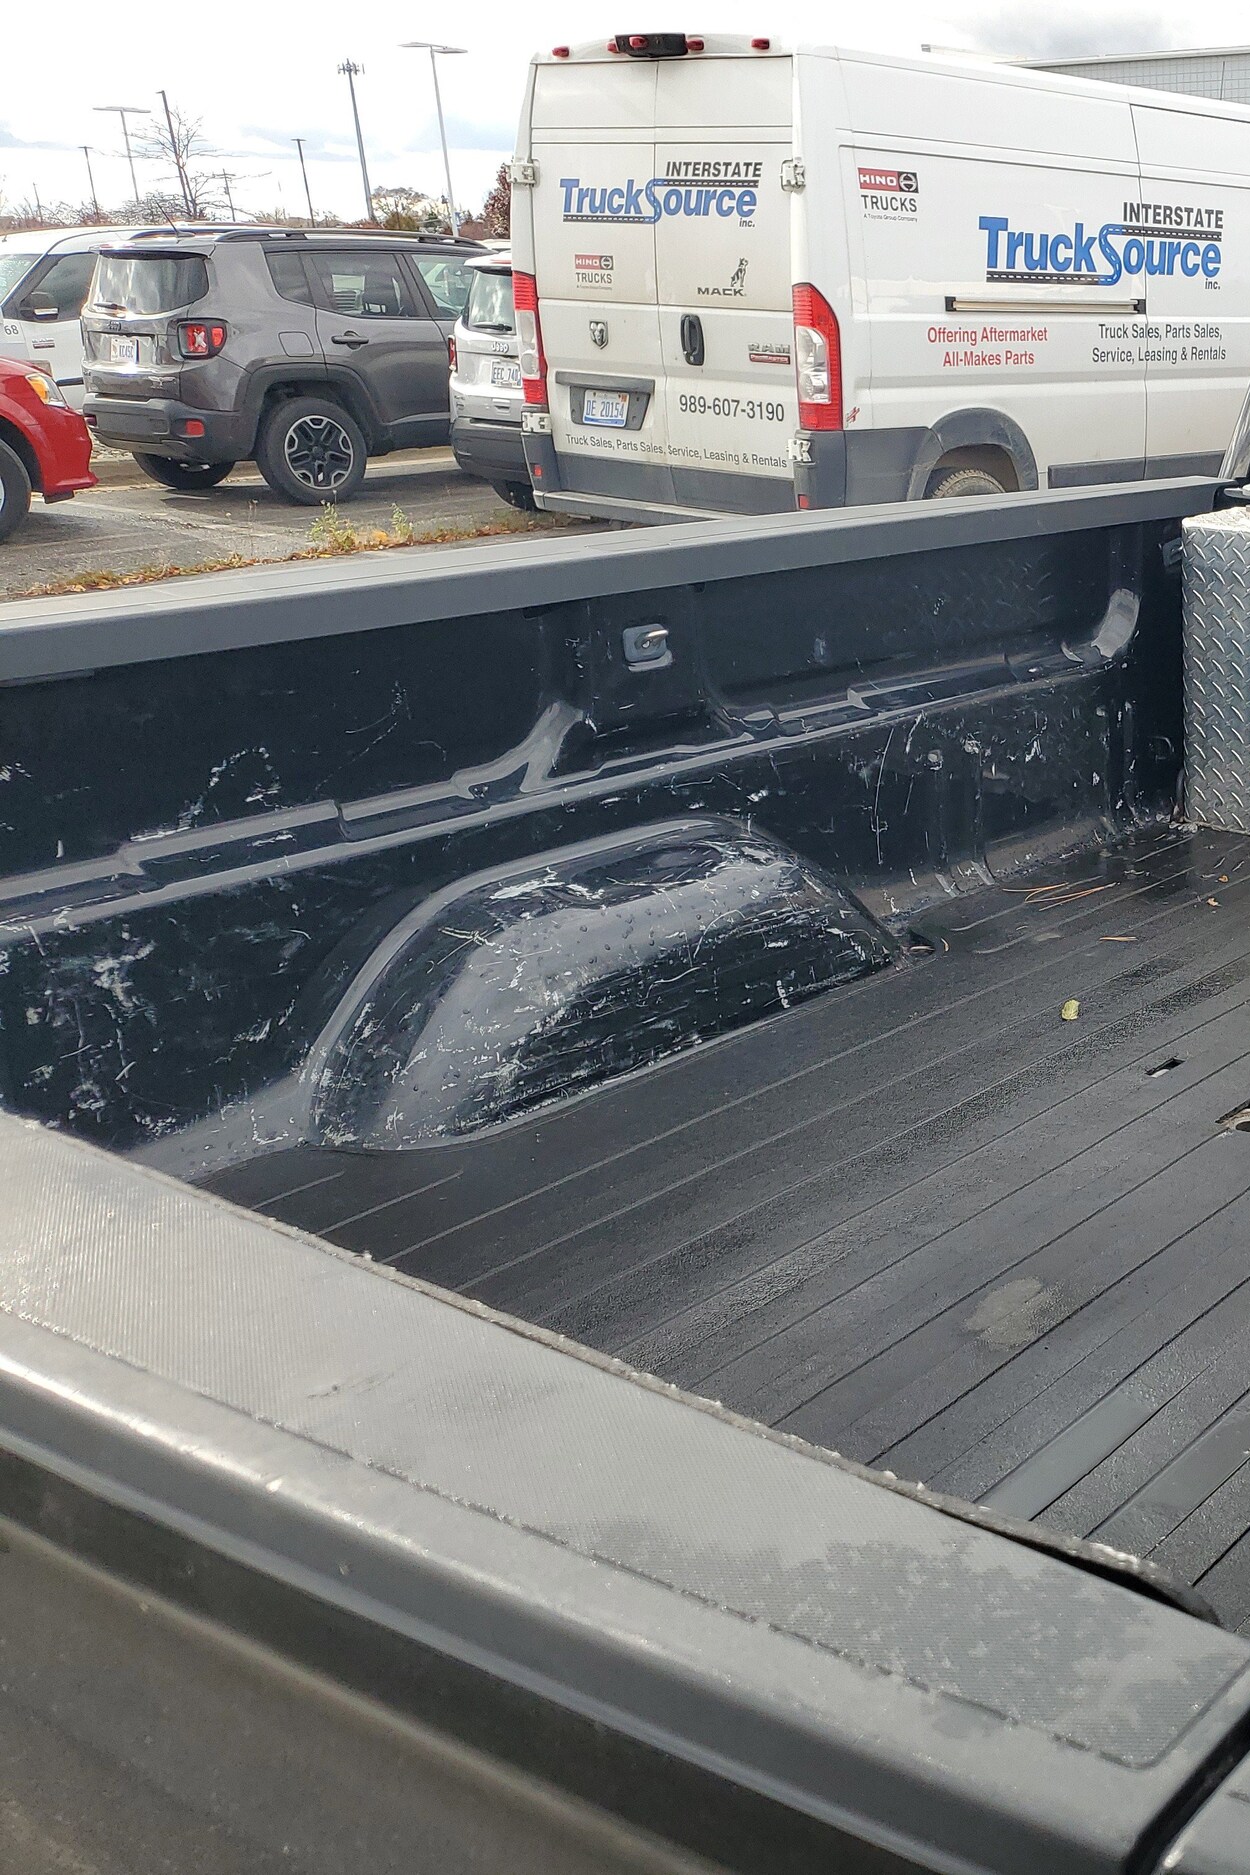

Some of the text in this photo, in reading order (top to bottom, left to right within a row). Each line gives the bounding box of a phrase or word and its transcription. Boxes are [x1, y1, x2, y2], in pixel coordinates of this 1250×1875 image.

[665, 161, 763, 178] INTERSTATE
[860, 174, 897, 186] HINO
[861, 194, 917, 212] TRUCKS
[739, 218, 755, 228] inc.
[1123, 201, 1224, 229] INTERSTATE
[576, 258, 600, 266] HINO
[576, 272, 612, 284] TRUCKS
[1204, 279, 1221, 290] inc.
[697, 287, 745, 297] MACK
[4, 324, 19, 335] 68
[927, 327, 1048, 346] Offering Aftermarket
[1098, 323, 1222, 341] Truck Sales, Parts Sales,
[748, 343, 791, 354] RAM
[1092, 345, 1226, 365] Service, Leasing & Rentals
[943, 350, 1035, 367] All-Makes Parts
[586, 400, 625, 418] DE 20154
[679, 394, 785, 422] 989-607-3190
[565, 434, 589, 446] Truck
[590, 436, 615, 450] Sales,
[616, 439, 638, 451] Parts
[667, 444, 702, 460] Service,
[704, 448, 740, 465] Leasing
[742, 453, 749, 464] &
[751, 454, 788, 468] Rentals
